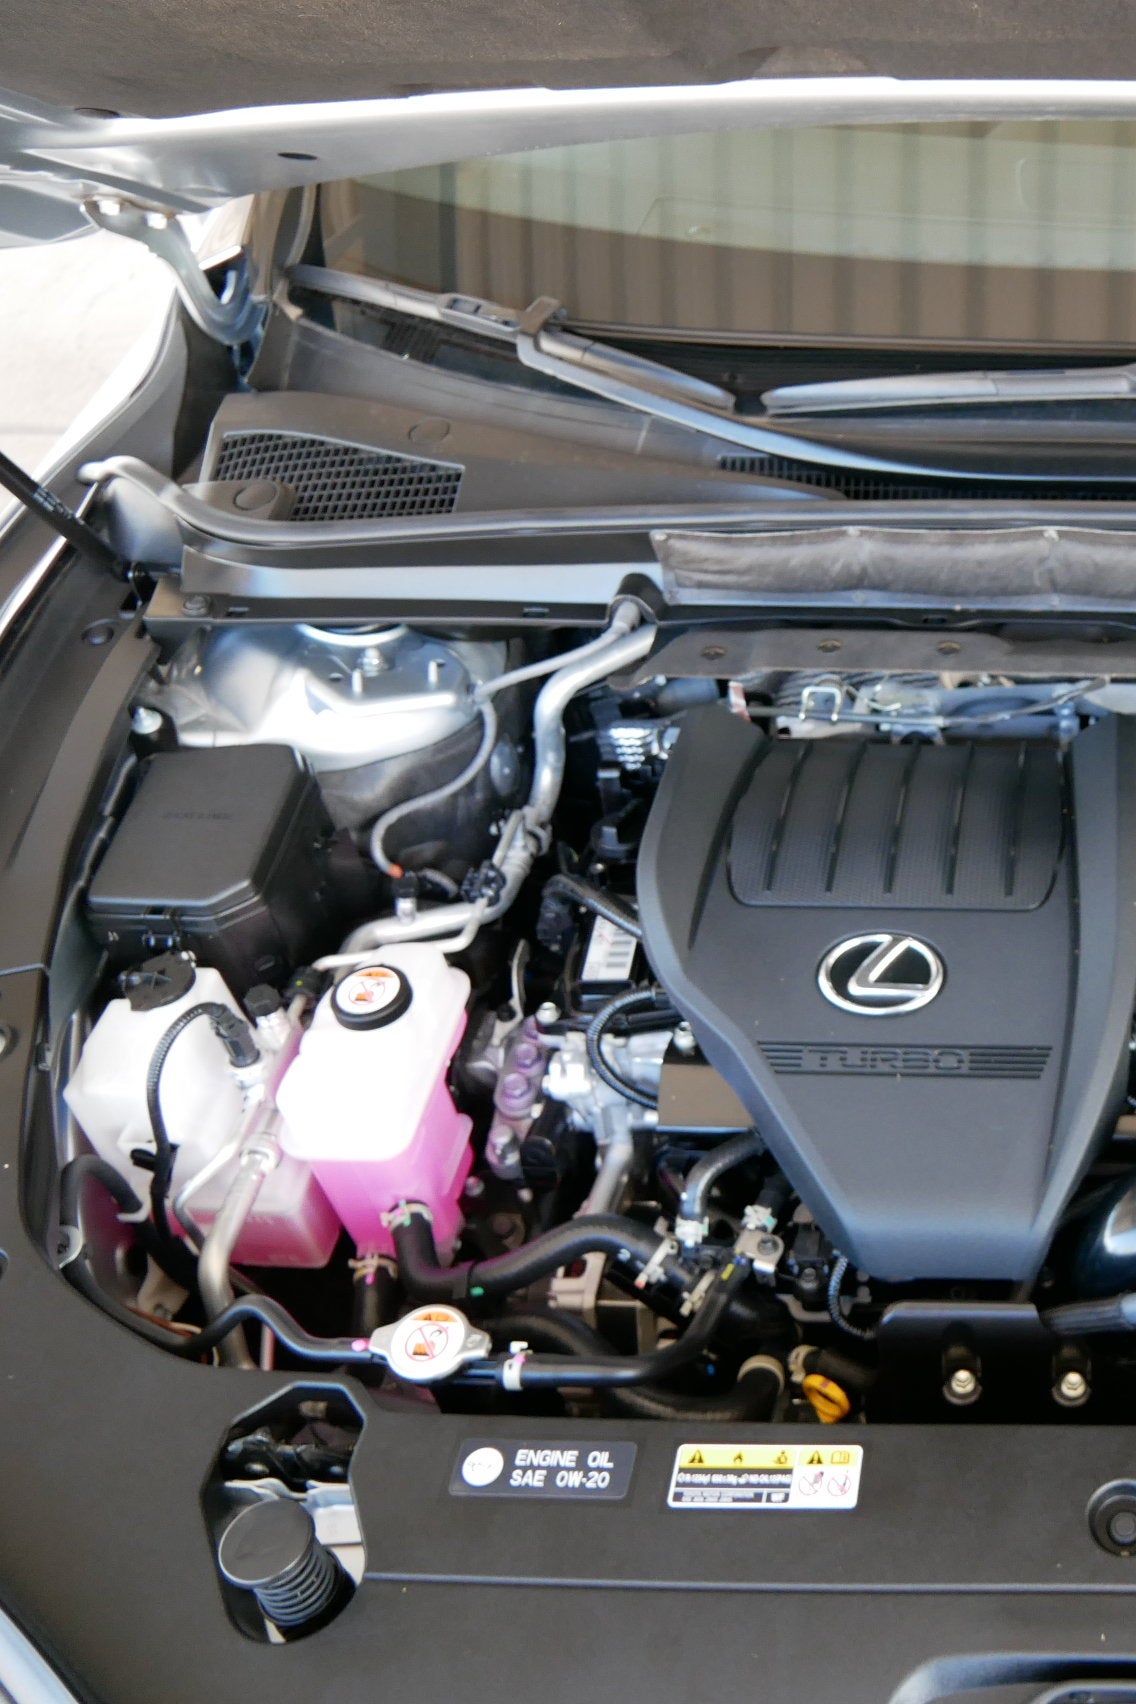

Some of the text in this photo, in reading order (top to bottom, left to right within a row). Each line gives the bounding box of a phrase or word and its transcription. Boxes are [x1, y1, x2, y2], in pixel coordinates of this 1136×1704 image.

[808, 1050, 966, 1070] TURBO
[515, 1449, 614, 1468] ENGINE OIL
[509, 1470, 610, 1488] SAE 0W-20
